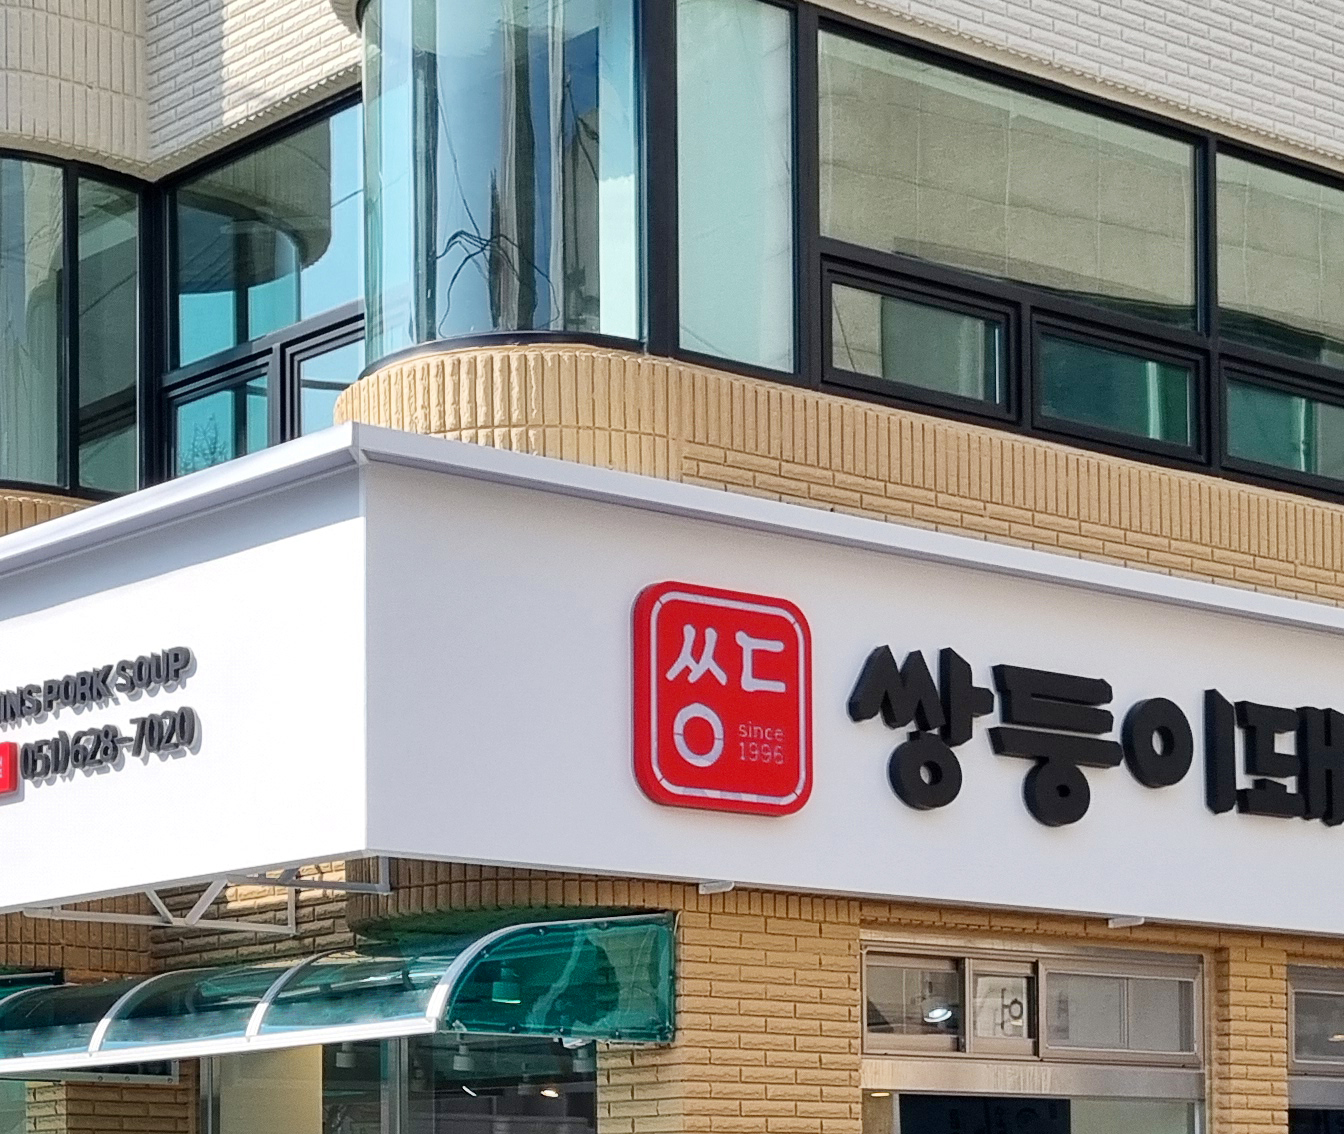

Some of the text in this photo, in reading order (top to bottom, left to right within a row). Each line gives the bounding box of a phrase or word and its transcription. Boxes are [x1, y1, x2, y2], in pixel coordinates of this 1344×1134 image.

[43, 664, 115, 712] PORK
[115, 646, 192, 693] SOUP
[738, 721, 784, 742] since
[739, 742, 784, 765] 1996
